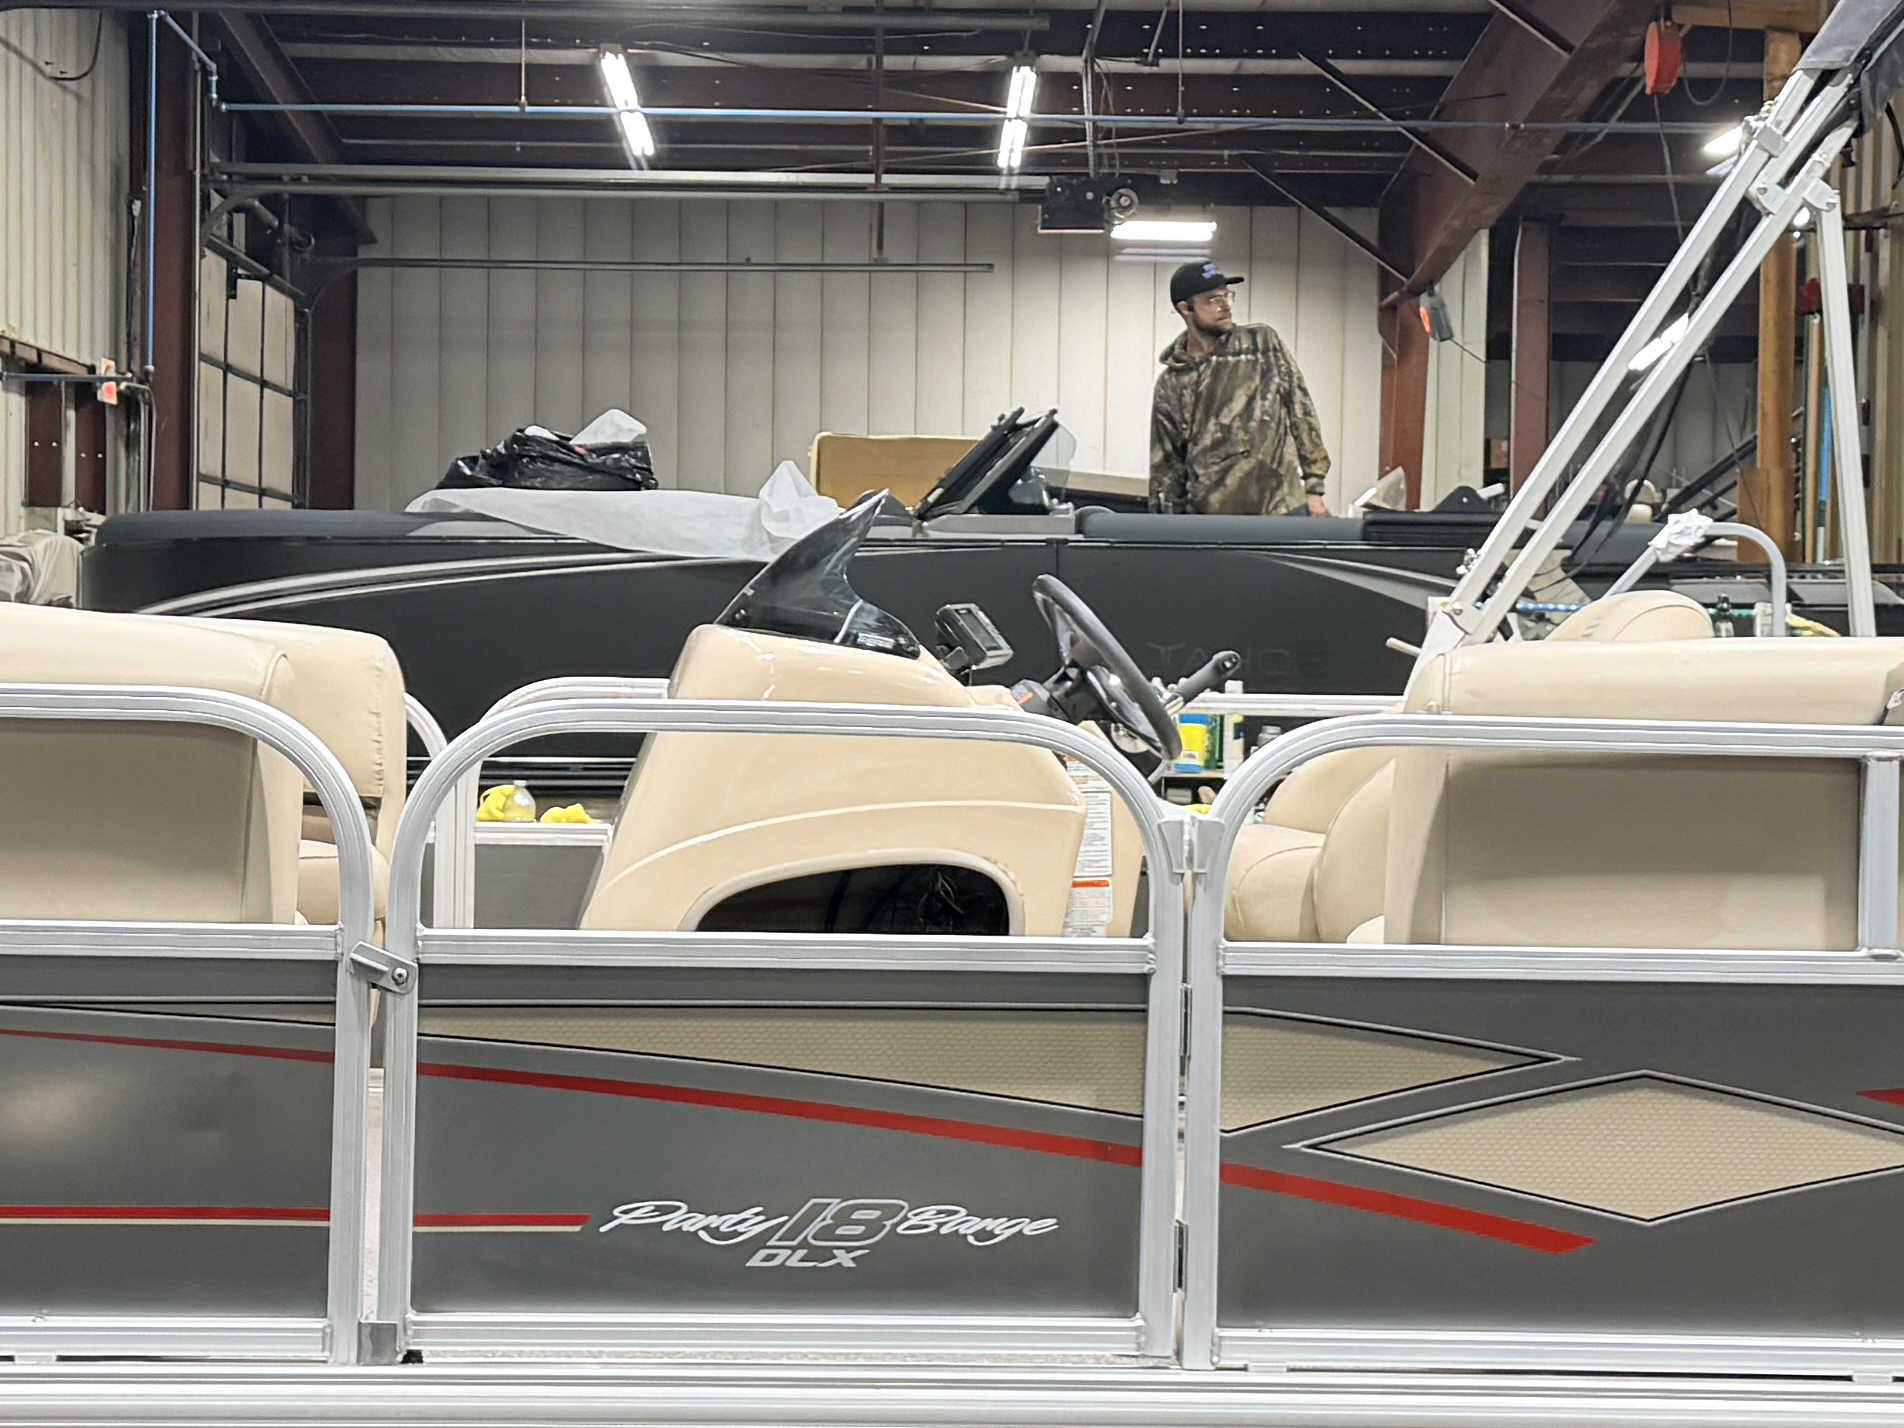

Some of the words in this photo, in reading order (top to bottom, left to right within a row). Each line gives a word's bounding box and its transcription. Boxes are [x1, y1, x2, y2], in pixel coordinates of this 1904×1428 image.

[599, 1200, 794, 1245] Party
[766, 1198, 908, 1246] 18
[897, 1204, 1060, 1246] Barge
[746, 1248, 870, 1267] DLX
